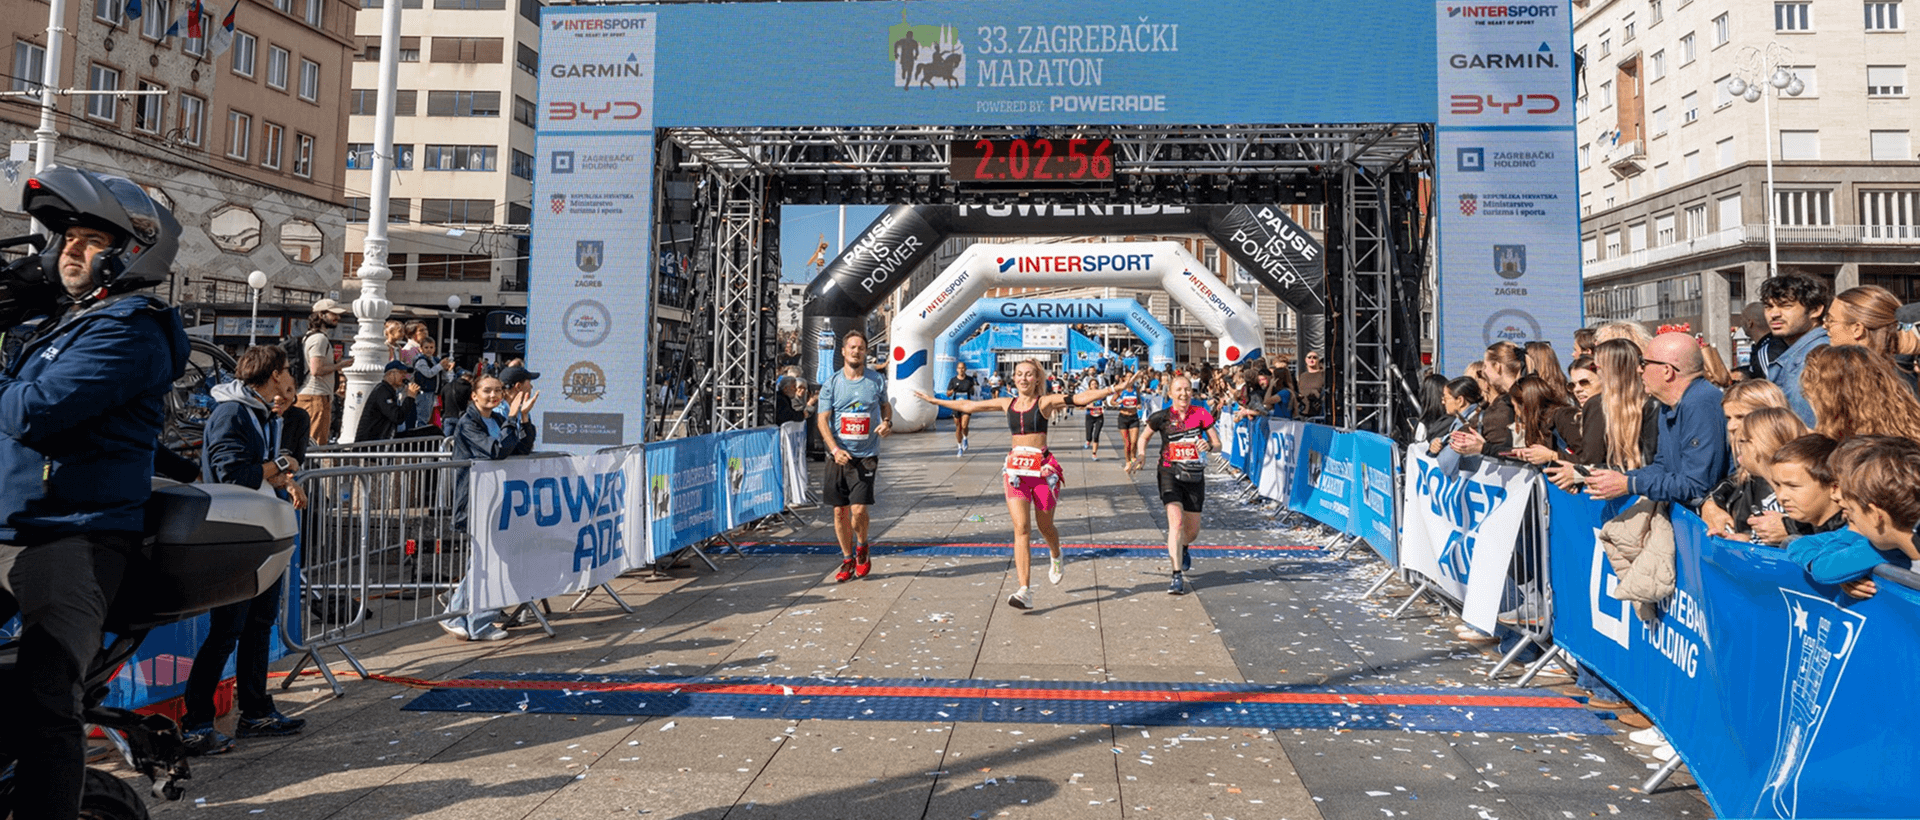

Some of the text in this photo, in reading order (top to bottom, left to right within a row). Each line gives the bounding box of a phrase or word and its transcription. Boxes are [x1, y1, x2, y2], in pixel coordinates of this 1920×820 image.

[1462, 5, 1558, 17] INTERSPORT
[564, 19, 646, 30] INTERSPORT
[977, 16, 1178, 54] 33. ZAGREBAČKI
[1450, 53, 1559, 68] GARMIN
[551, 64, 643, 78] GARMIN
[977, 58, 1103, 86] MARATON
[549, 102, 642, 120] BYD
[977, 101, 1027, 112] POWERED
[1051, 95, 1168, 112] POWERADE
[1451, 94, 1560, 114] BYD
[974, 139, 1112, 179] 2:02:56
[1493, 150, 1555, 160] ZAGREBAČKI
[1493, 160, 1536, 168] HOLDING
[1521, 209, 1546, 217] sporta
[842, 213, 897, 267] PAUSE
[1257, 207, 1319, 262] PAUSE
[869, 241, 890, 263] IS
[1263, 236, 1287, 257] IS
[861, 235, 923, 294] POWER
[1018, 254, 1154, 273] INTERSPORT
[1229, 229, 1297, 290] POWER
[575, 280, 603, 288] ZAGREB
[925, 270, 970, 314] INTERSPORT
[1495, 287, 1528, 296] ZAGREB
[1188, 274, 1236, 318] INTERSPORT
[1000, 302, 1104, 319] GARMIN
[948, 311, 977, 338] GARMIN
[1131, 312, 1160, 339] GARMIN
[845, 423, 865, 432] 3291
[1012, 457, 1035, 467] 2737
[1175, 448, 1195, 457] 3162
[498, 467, 626, 531] POWER
[572, 515, 624, 572] ADE
[1641, 617, 1699, 679] HOLDING
